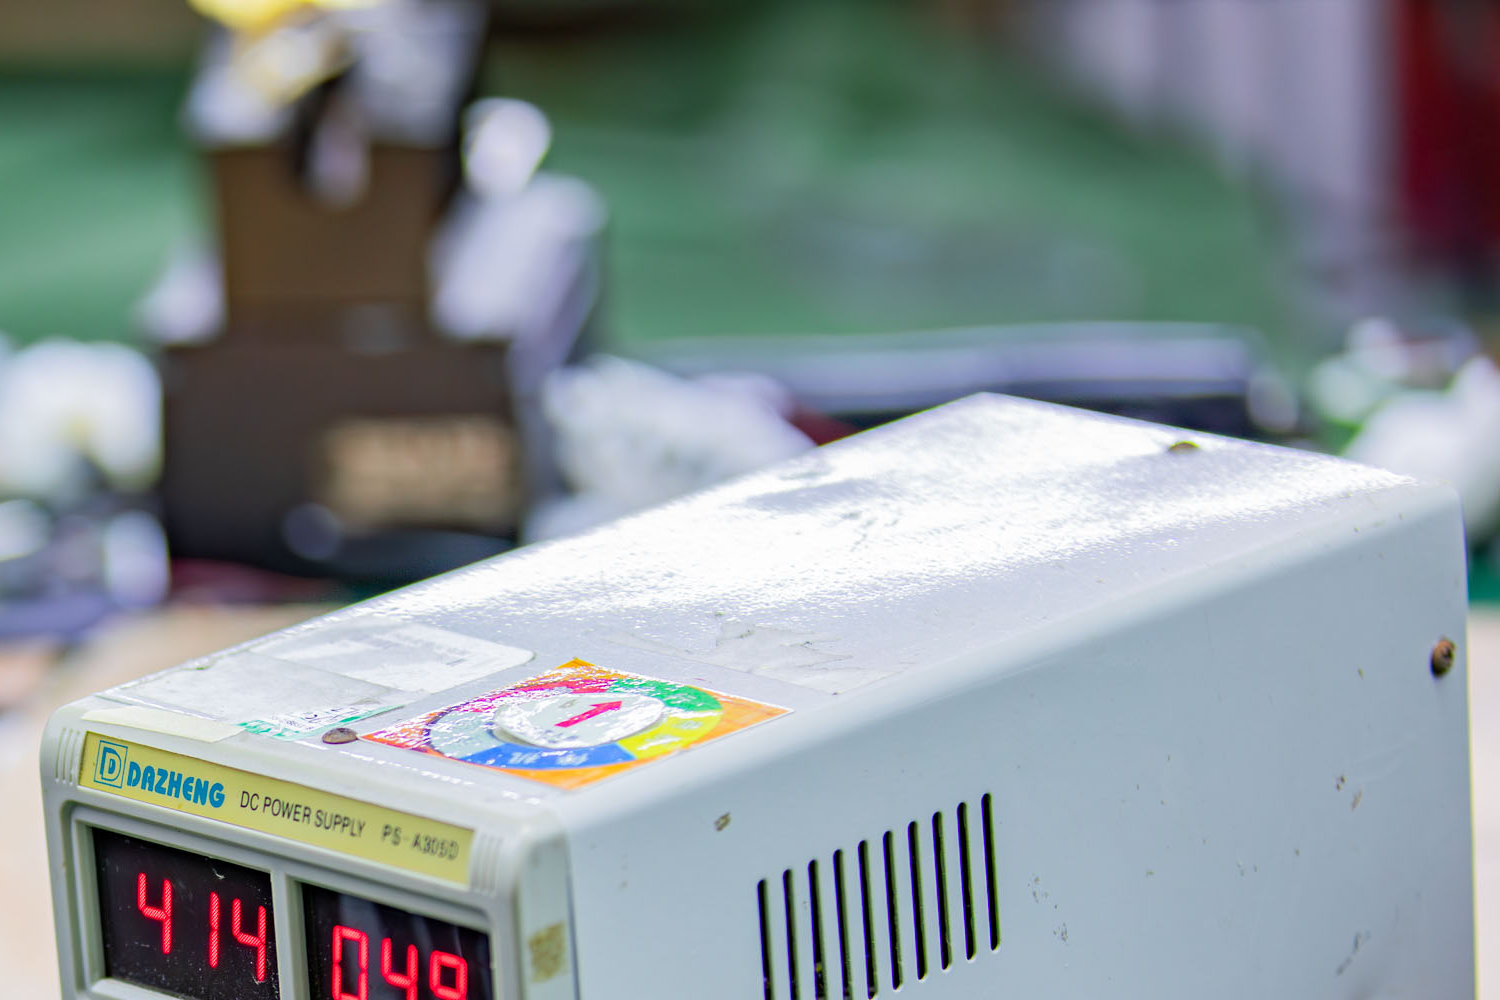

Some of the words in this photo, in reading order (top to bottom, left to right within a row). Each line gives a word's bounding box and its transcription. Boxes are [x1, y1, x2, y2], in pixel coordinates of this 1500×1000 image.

[126, 760, 226, 808] DAZHENG
[240, 790, 260, 811] DC
[263, 796, 311, 825] POWER
[315, 809, 366, 838] SUPPLY
